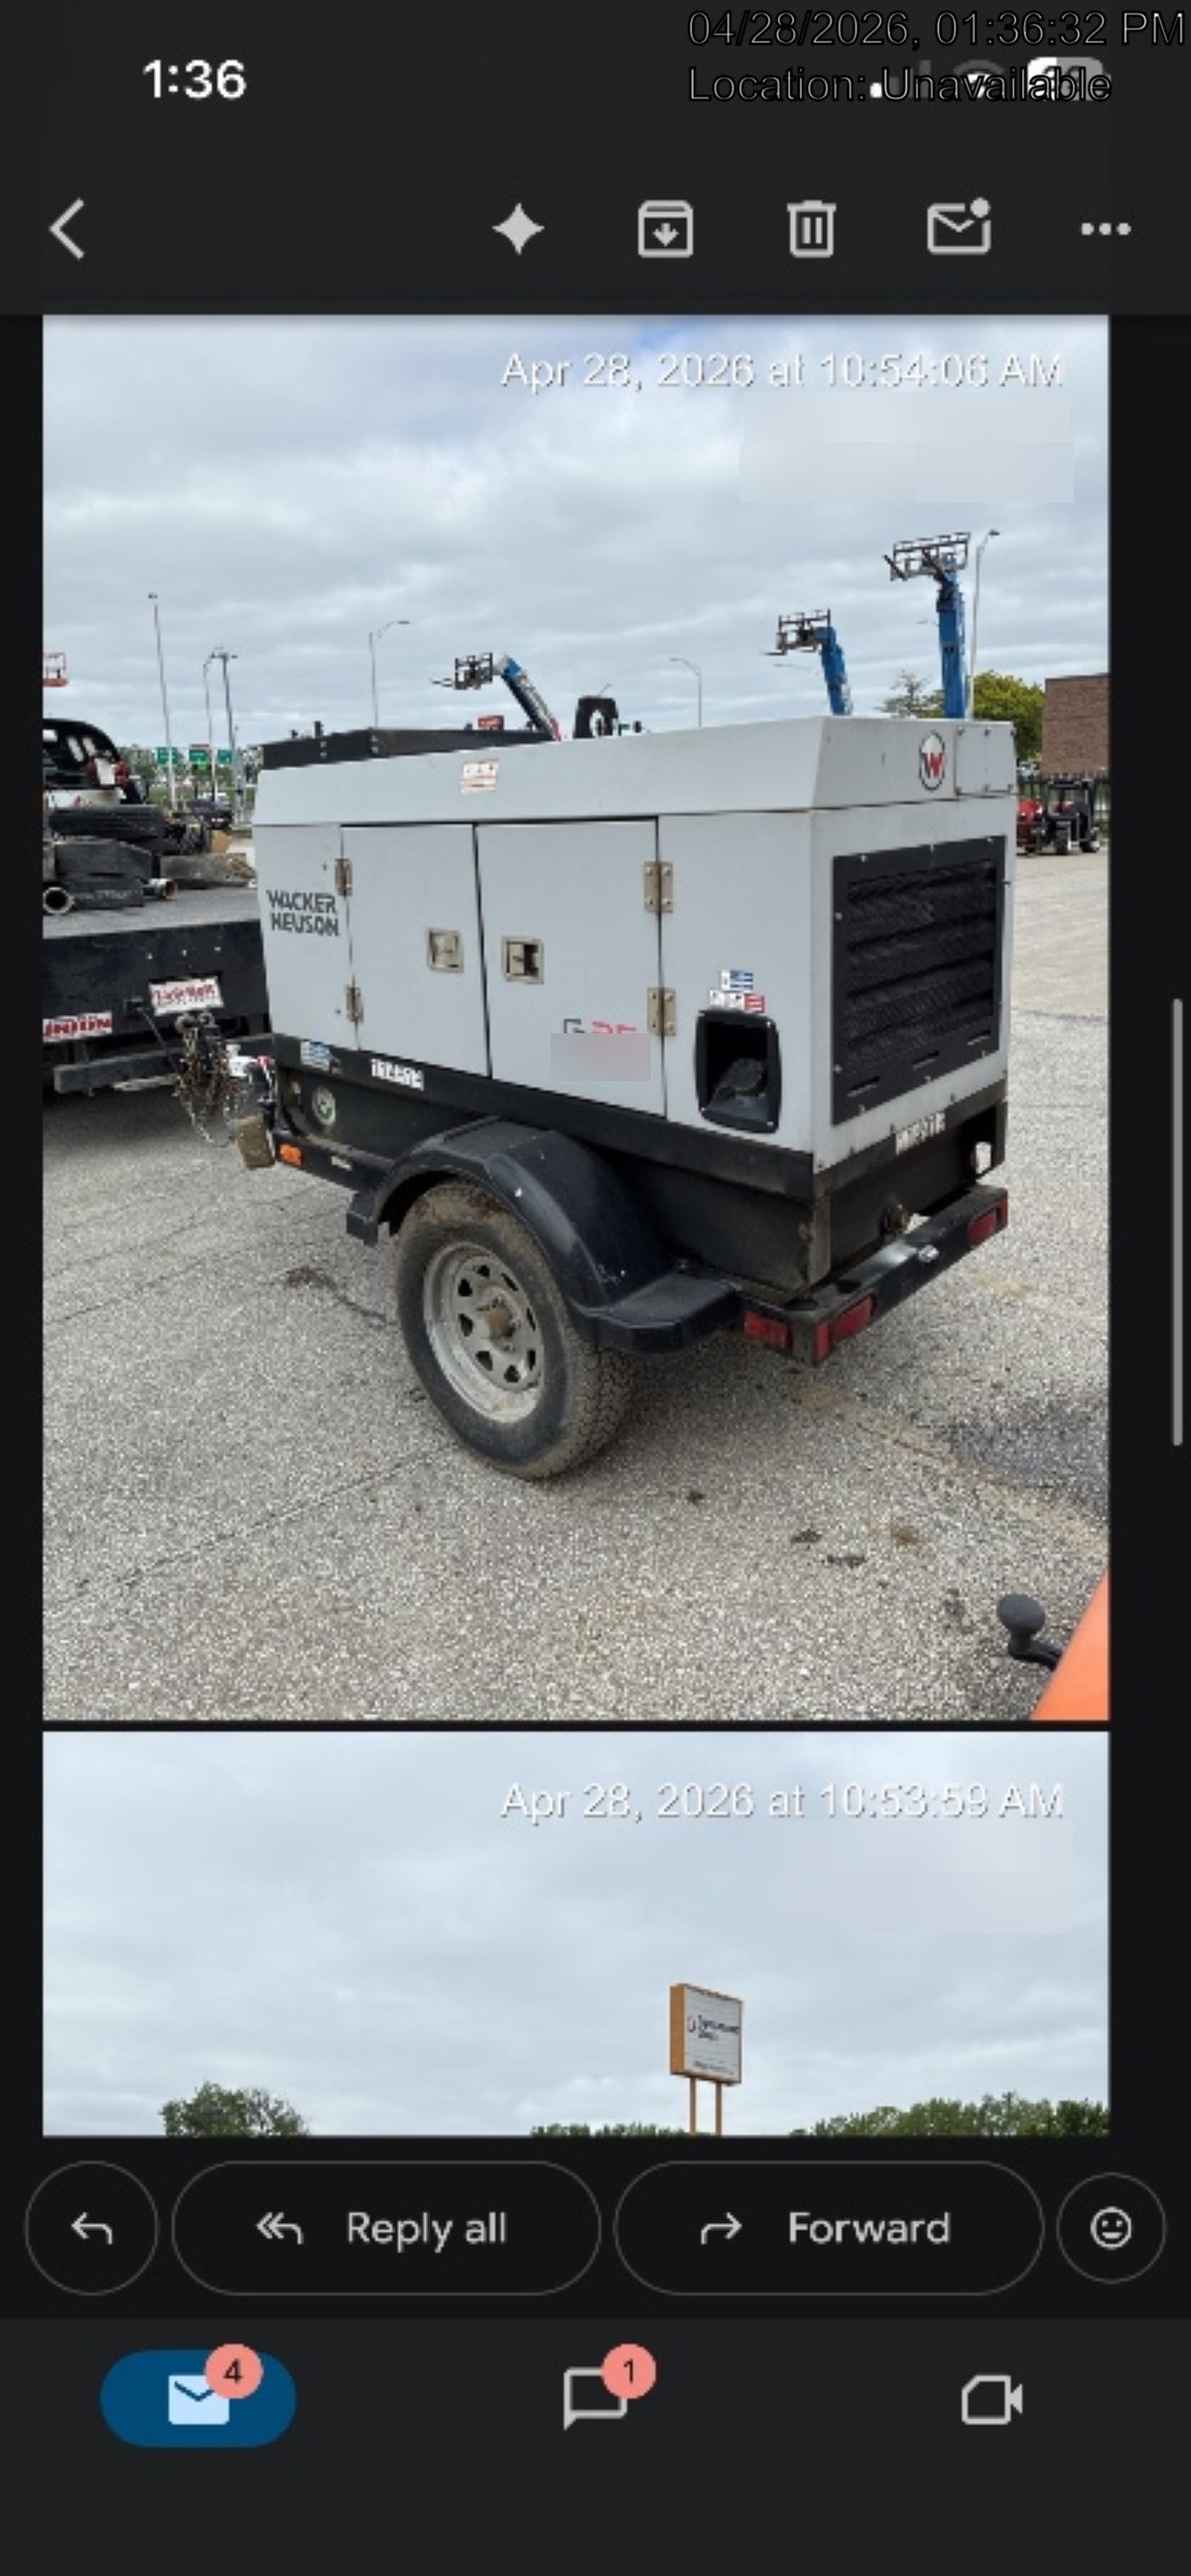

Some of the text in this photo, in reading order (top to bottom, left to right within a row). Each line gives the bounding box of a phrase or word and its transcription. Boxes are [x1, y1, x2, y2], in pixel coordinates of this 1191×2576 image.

[143, 60, 247, 99] 1:36
[265, 889, 336, 914] WACKER
[347, 2211, 506, 2254] Reply all
[789, 2211, 950, 2245] Forward
[222, 2358, 243, 2383] 4
[623, 2359, 634, 2383] 1
